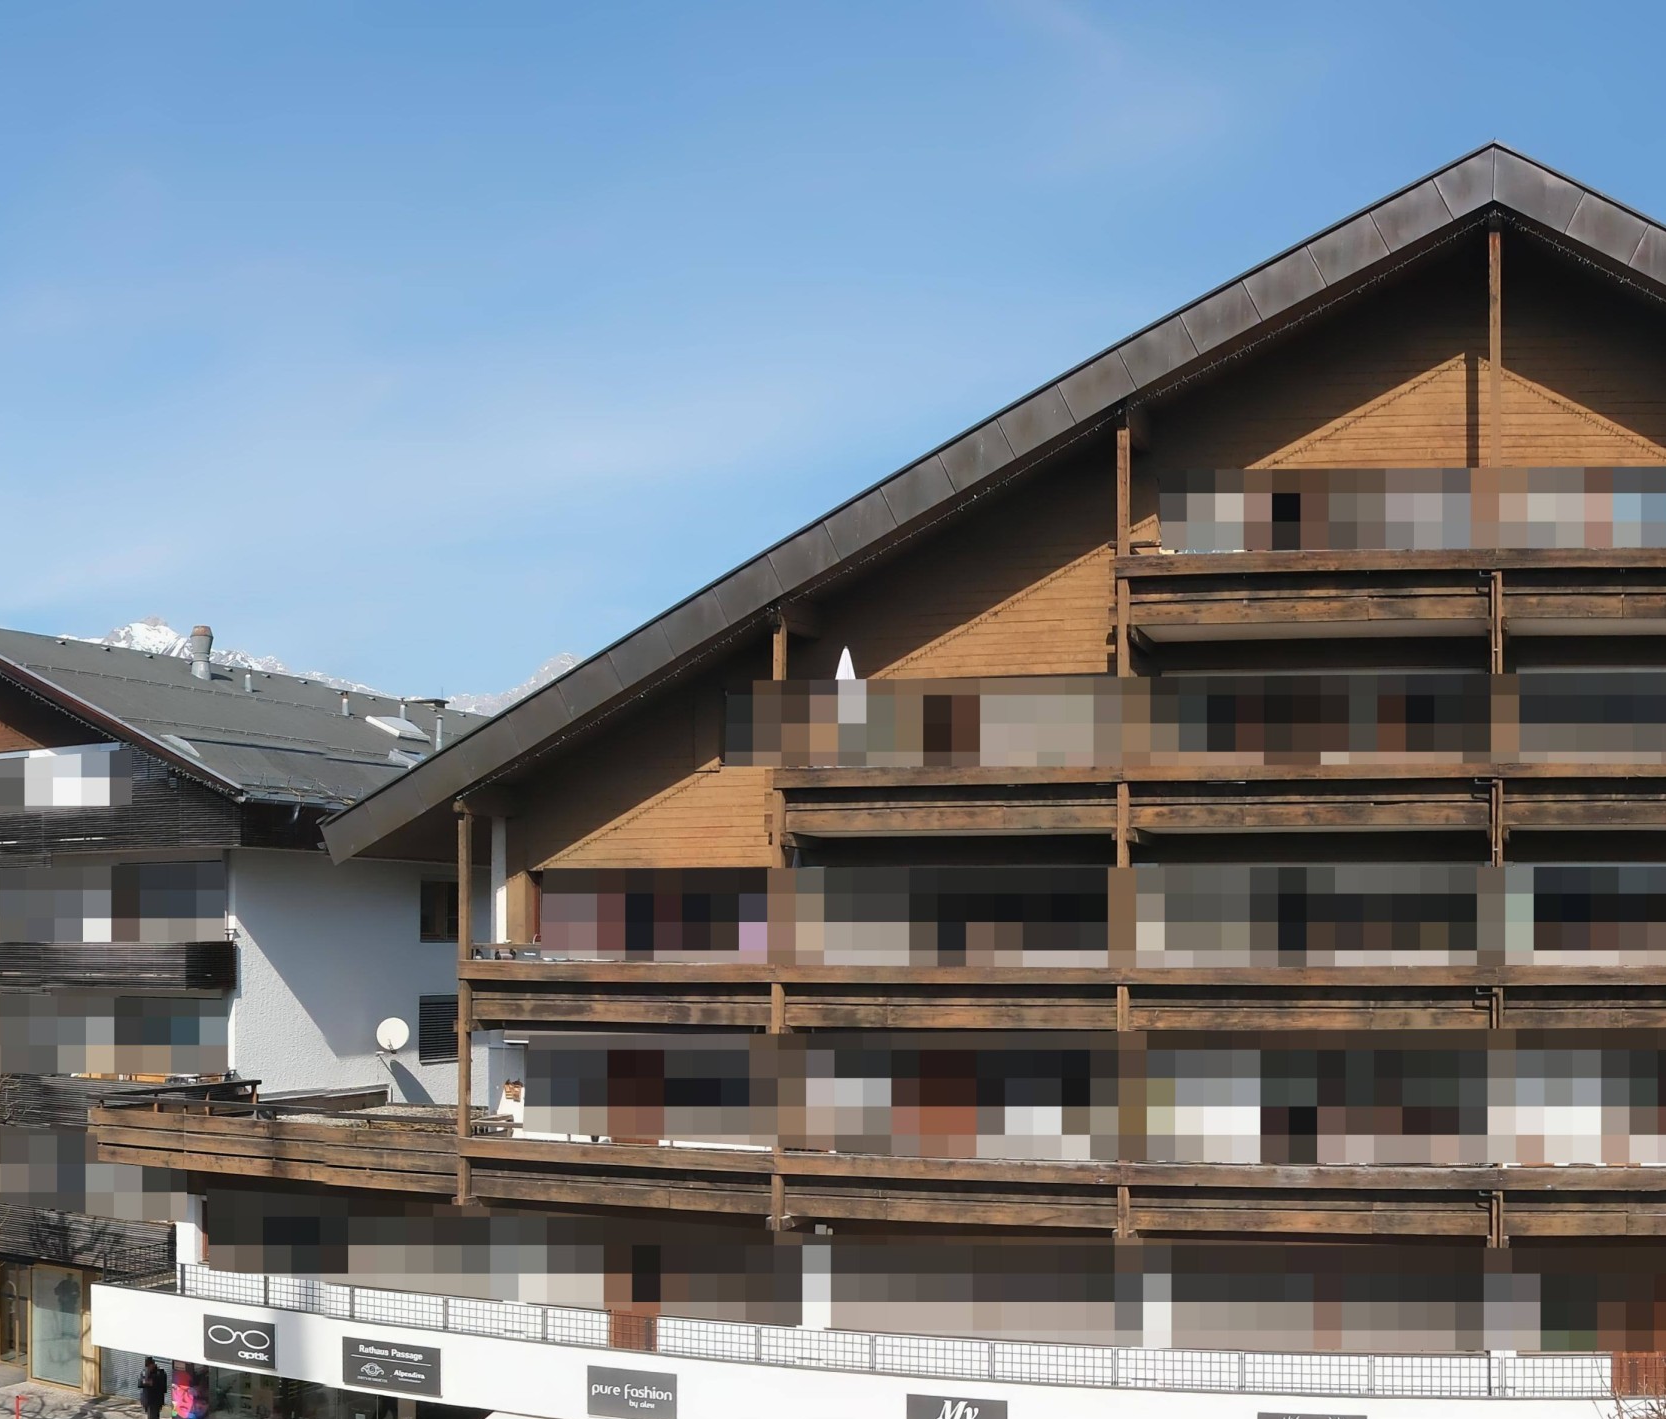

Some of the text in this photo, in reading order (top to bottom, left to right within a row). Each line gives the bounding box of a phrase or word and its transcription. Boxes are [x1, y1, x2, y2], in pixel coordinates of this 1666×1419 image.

[237, 1350, 269, 1362] optik
[359, 1344, 423, 1362] Rathaus Passage
[591, 1383, 673, 1401] pure fashion
[628, 1399, 639, 1409] by
